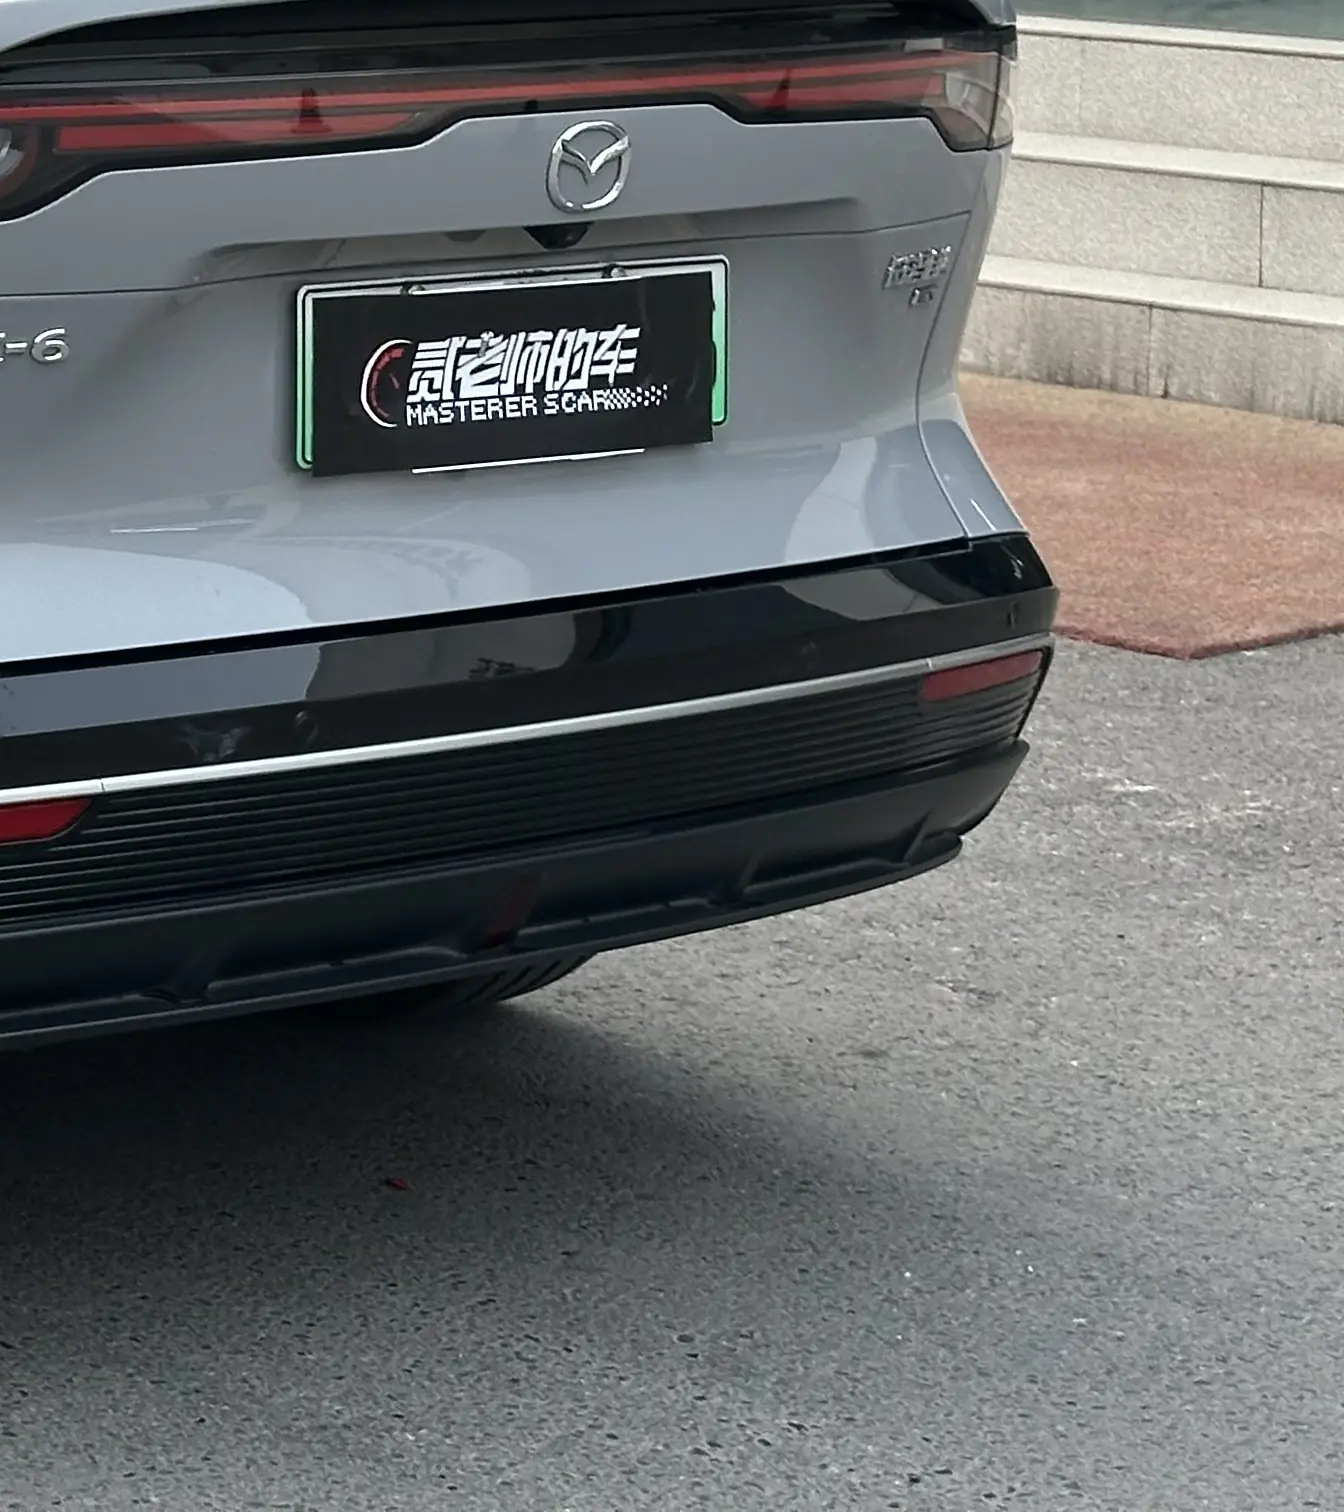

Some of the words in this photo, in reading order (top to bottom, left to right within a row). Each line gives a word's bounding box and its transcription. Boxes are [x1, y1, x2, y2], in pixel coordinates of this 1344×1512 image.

[408, 324, 640, 404] 贰老师的车
[406, 395, 538, 426] MASTERER
